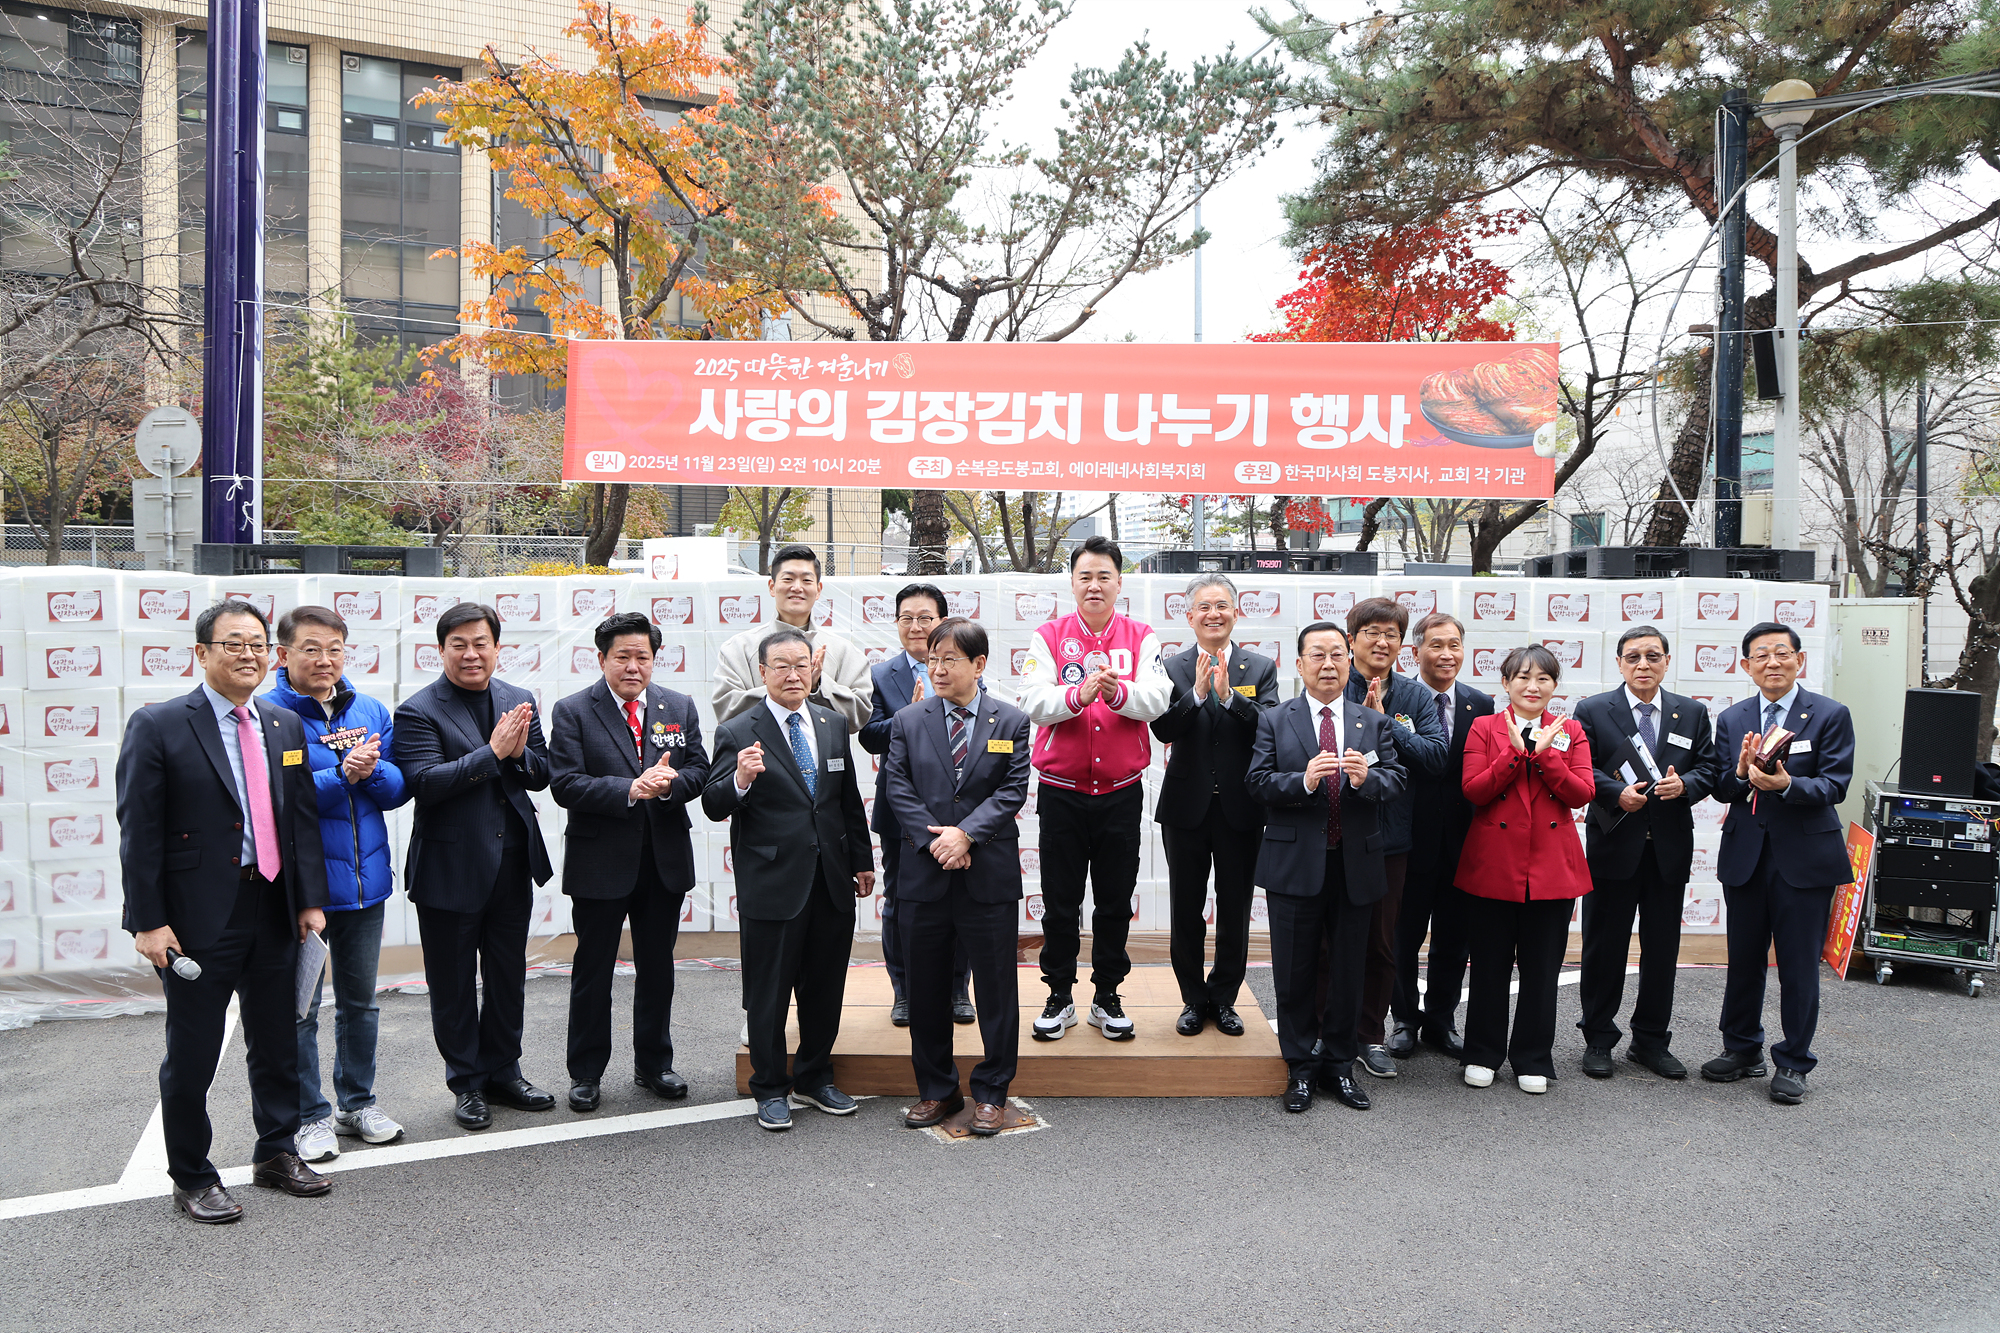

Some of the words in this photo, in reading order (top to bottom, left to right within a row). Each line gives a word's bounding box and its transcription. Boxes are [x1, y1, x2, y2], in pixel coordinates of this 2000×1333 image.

[694, 358, 740, 382] 2025
[744, 353, 814, 380] 따뜻한
[817, 353, 888, 382] 겨울나기
[688, 388, 848, 442] 사랑의
[866, 390, 1082, 445] 김장김치
[1104, 393, 1269, 447] 나누기
[1290, 393, 1411, 450] 행사
[592, 453, 619, 470] 일시
[628, 454, 678, 472] 2025년
[683, 455, 714, 472] 11월
[718, 456, 776, 474] 23일(일)
[778, 457, 806, 474] 오전
[812, 458, 844, 474] 10시
[848, 458, 882, 475] 20분
[914, 459, 944, 476] 주최
[955, 460, 1064, 478] 순복음도봉교회,
[1068, 460, 1206, 480] 에이레네사회복지회
[1241, 463, 1272, 481] 후원
[1284, 464, 1362, 482] 한국마사회
[1366, 465, 1434, 484] 도봉지사,
[1438, 466, 1470, 484] 교회
[1474, 466, 1490, 484] 각
[1494, 466, 1526, 485] 기관
[1256, 560, 1282, 568] LOGISALL
[1109, 648, 1133, 676] D
[666, 724, 681, 732] 의장
[652, 732, 686, 747] 안병건
